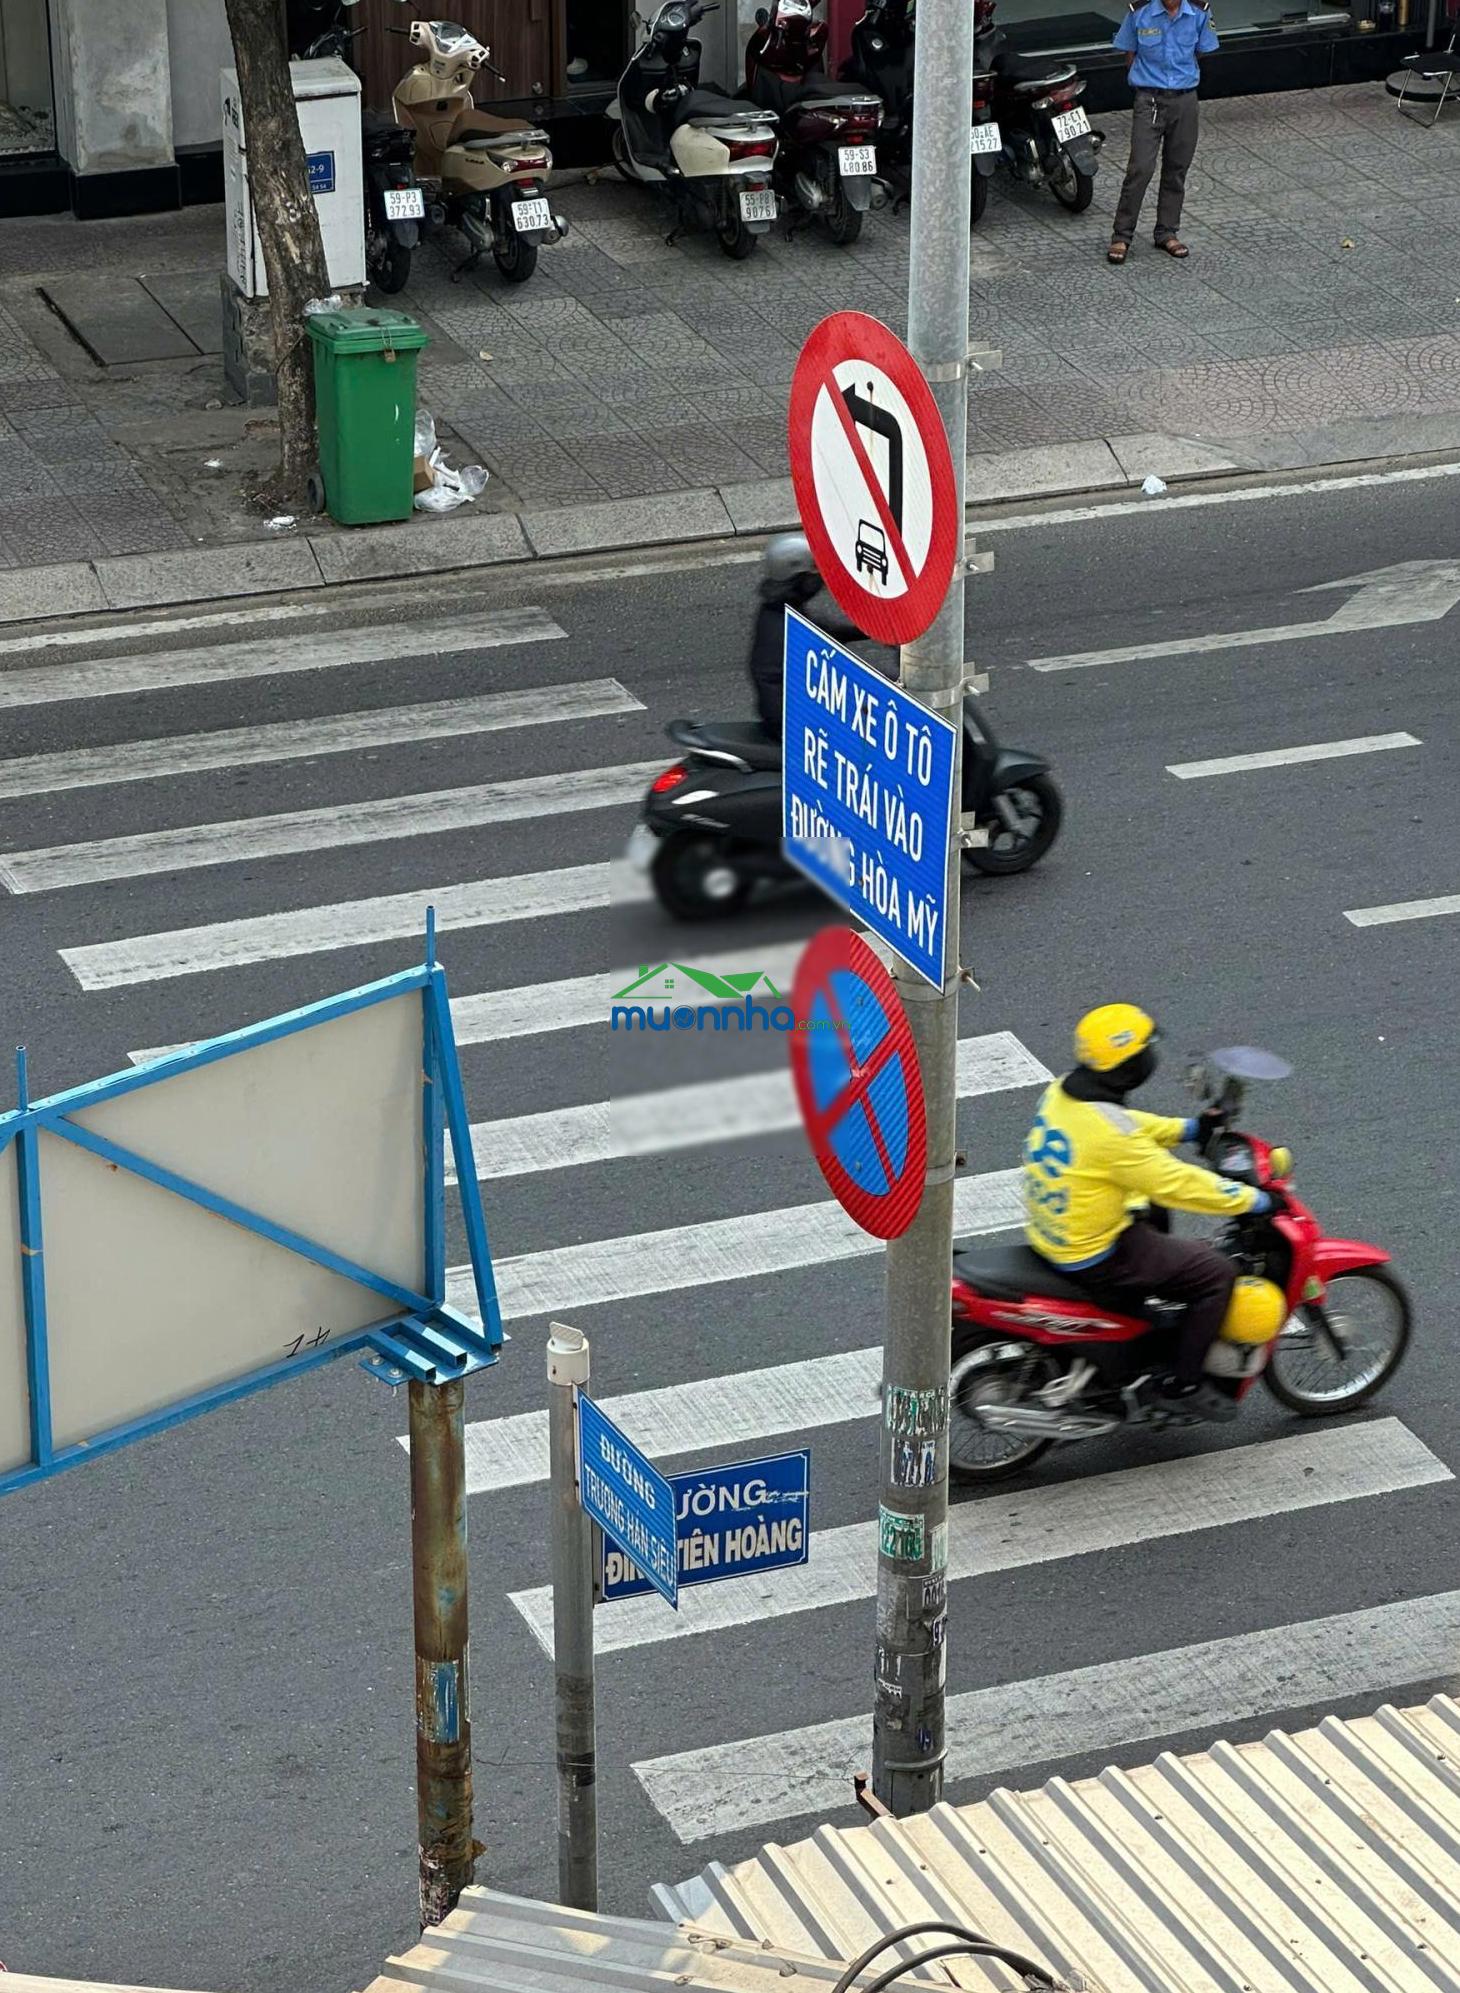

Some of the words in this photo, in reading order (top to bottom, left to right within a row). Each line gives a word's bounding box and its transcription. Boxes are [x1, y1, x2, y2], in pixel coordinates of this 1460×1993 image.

[1057, 110, 1082, 128] 72-C1
[844, 149, 870, 161] 59-S3
[389, 192, 417, 205] 59-P3
[746, 205, 771, 218] 9076
[805, 648, 847, 723] CẤM
[852, 683, 879, 747] XE
[884, 700, 899, 761] Ô
[906, 723, 932, 786] TÔ
[804, 726, 829, 790] RẼ
[834, 750, 878, 830] TRÁI
[884, 784, 923, 863] VÀO
[861, 850, 901, 928] HÒA
[908, 894, 938, 957] MỸ
[599, 1434, 656, 1510] ĐƯỜNG
[676, 1479, 767, 1521] ƯỜNG
[606, 1552, 646, 1586] ĐIN
[725, 1514, 803, 1563] HOÀNG
